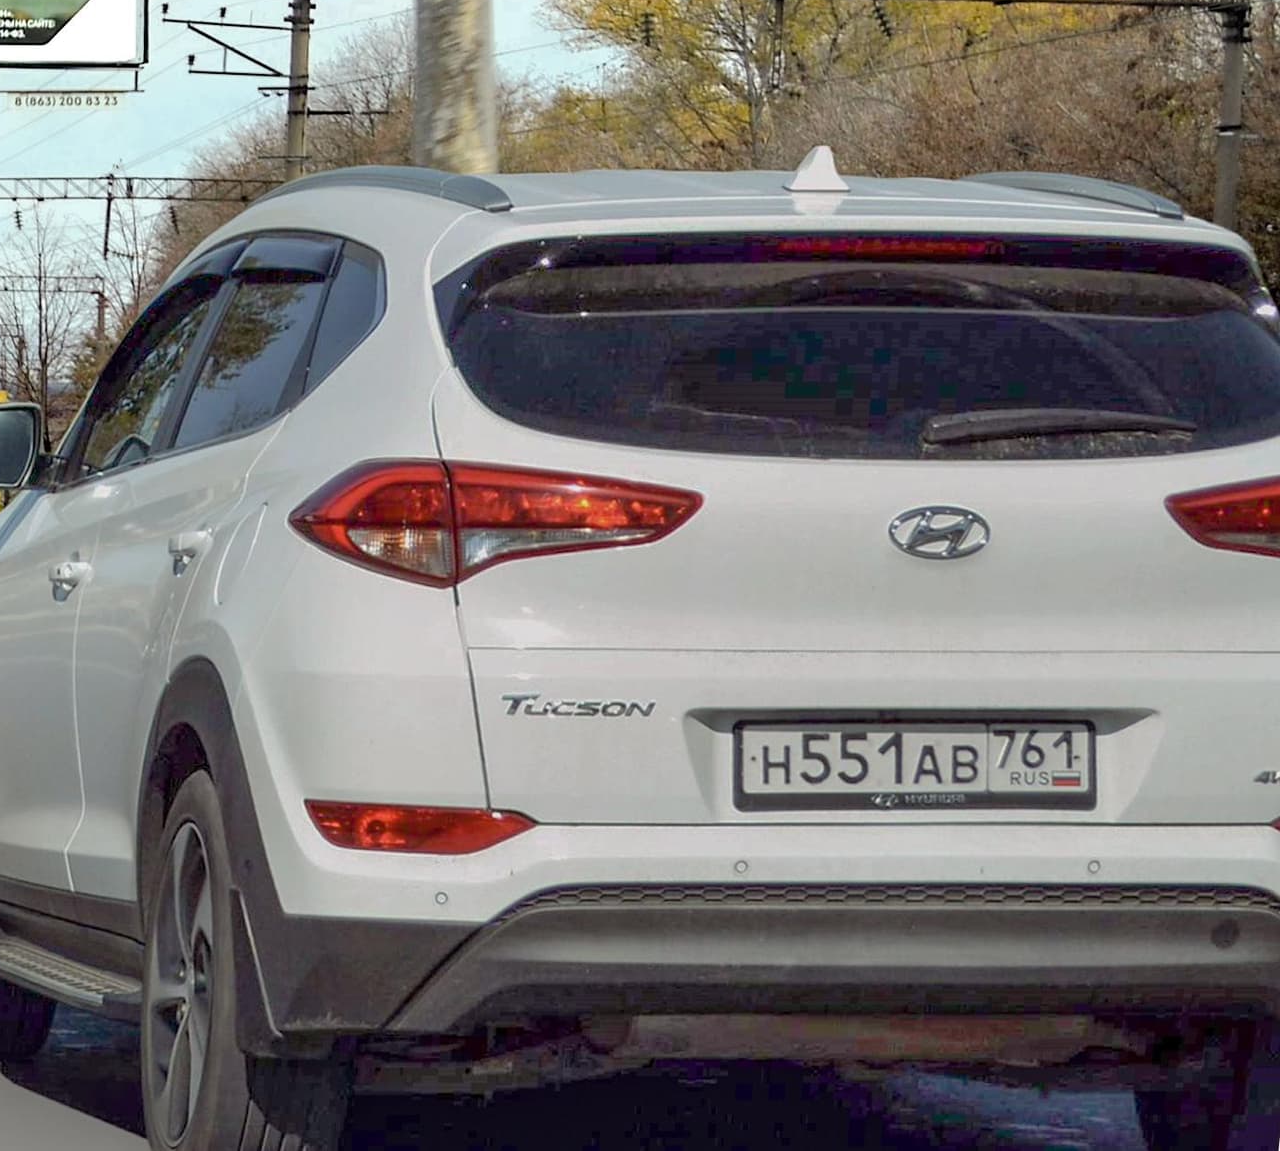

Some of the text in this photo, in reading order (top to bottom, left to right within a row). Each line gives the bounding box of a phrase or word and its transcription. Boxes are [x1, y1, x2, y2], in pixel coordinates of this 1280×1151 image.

[14, 96, 119, 107] 8 (863) 200 83 23
[992, 729, 1075, 770] 761
[1010, 771, 1050, 786] RUS
